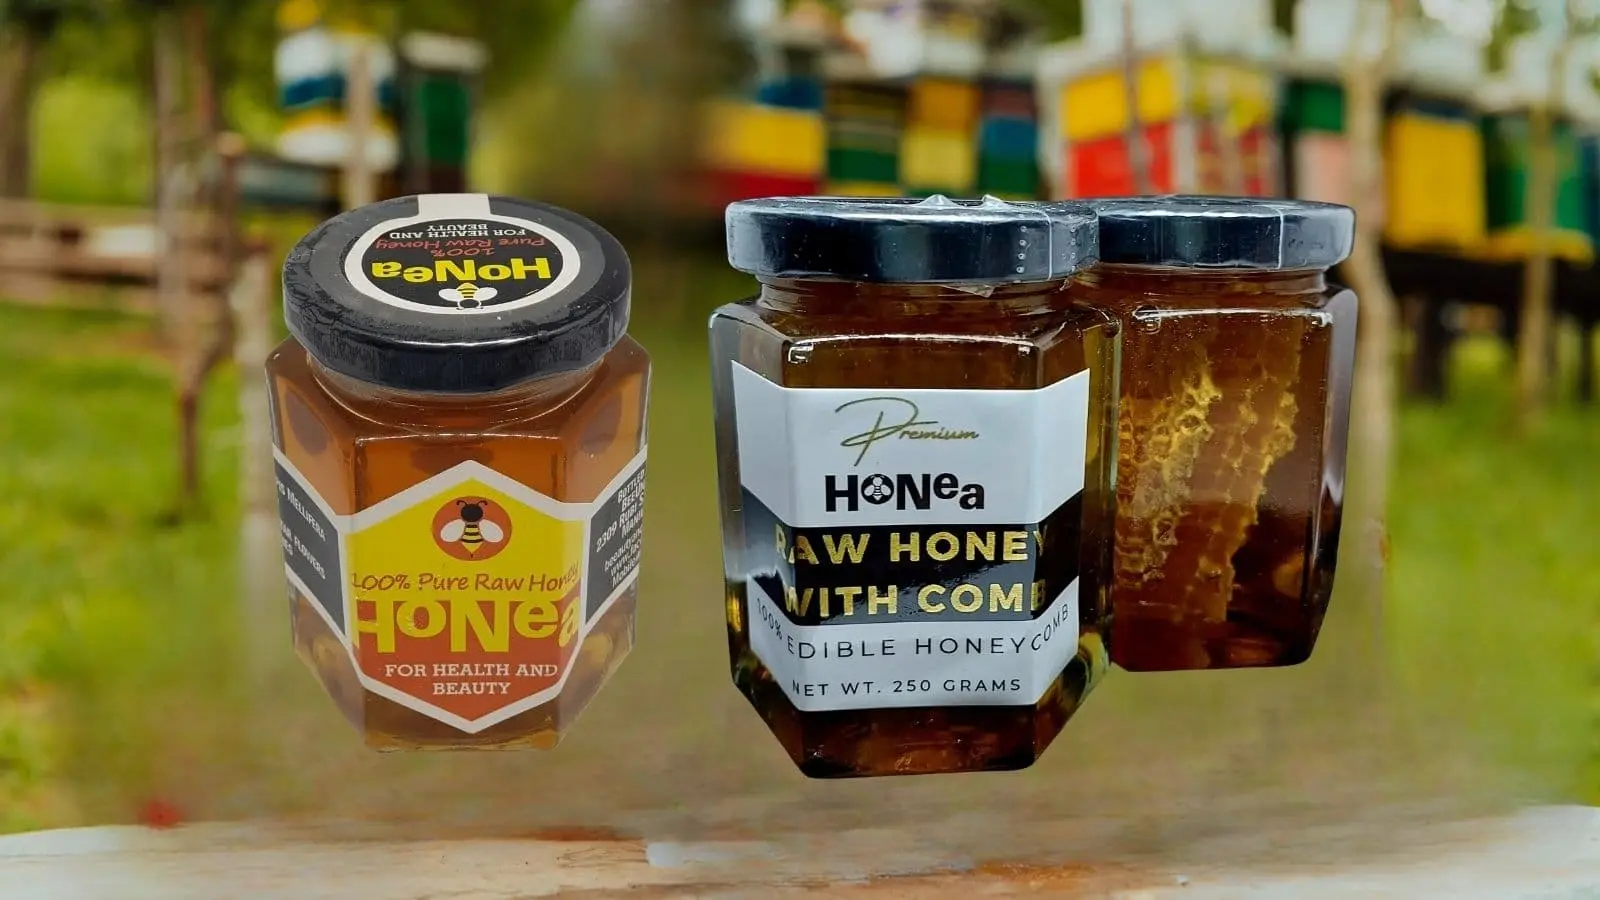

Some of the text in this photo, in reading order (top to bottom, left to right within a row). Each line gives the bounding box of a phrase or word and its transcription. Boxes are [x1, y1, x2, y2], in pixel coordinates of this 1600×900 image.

[427, 224, 488, 232] BEAUTY
[374, 238, 545, 250] Pure Raw Honey
[430, 247, 496, 257] 100%
[834, 396, 980, 467] Premium
[596, 519, 618, 553] 2309
[619, 503, 638, 529] RUBI
[294, 535, 327, 580] FLOWERS
[775, 524, 1047, 566] RAW HONEY
[352, 561, 580, 592] 100% Pure Raw Honey
[784, 581, 1047, 618] WITH COMB
[756, 597, 1070, 660] 100% EDIBLE HONEYCOMB
[385, 663, 559, 677] FOR HEALTH AND
[432, 682, 512, 696] BEAUTY
[791, 679, 1022, 697] NET WT. 250 GRAMS
